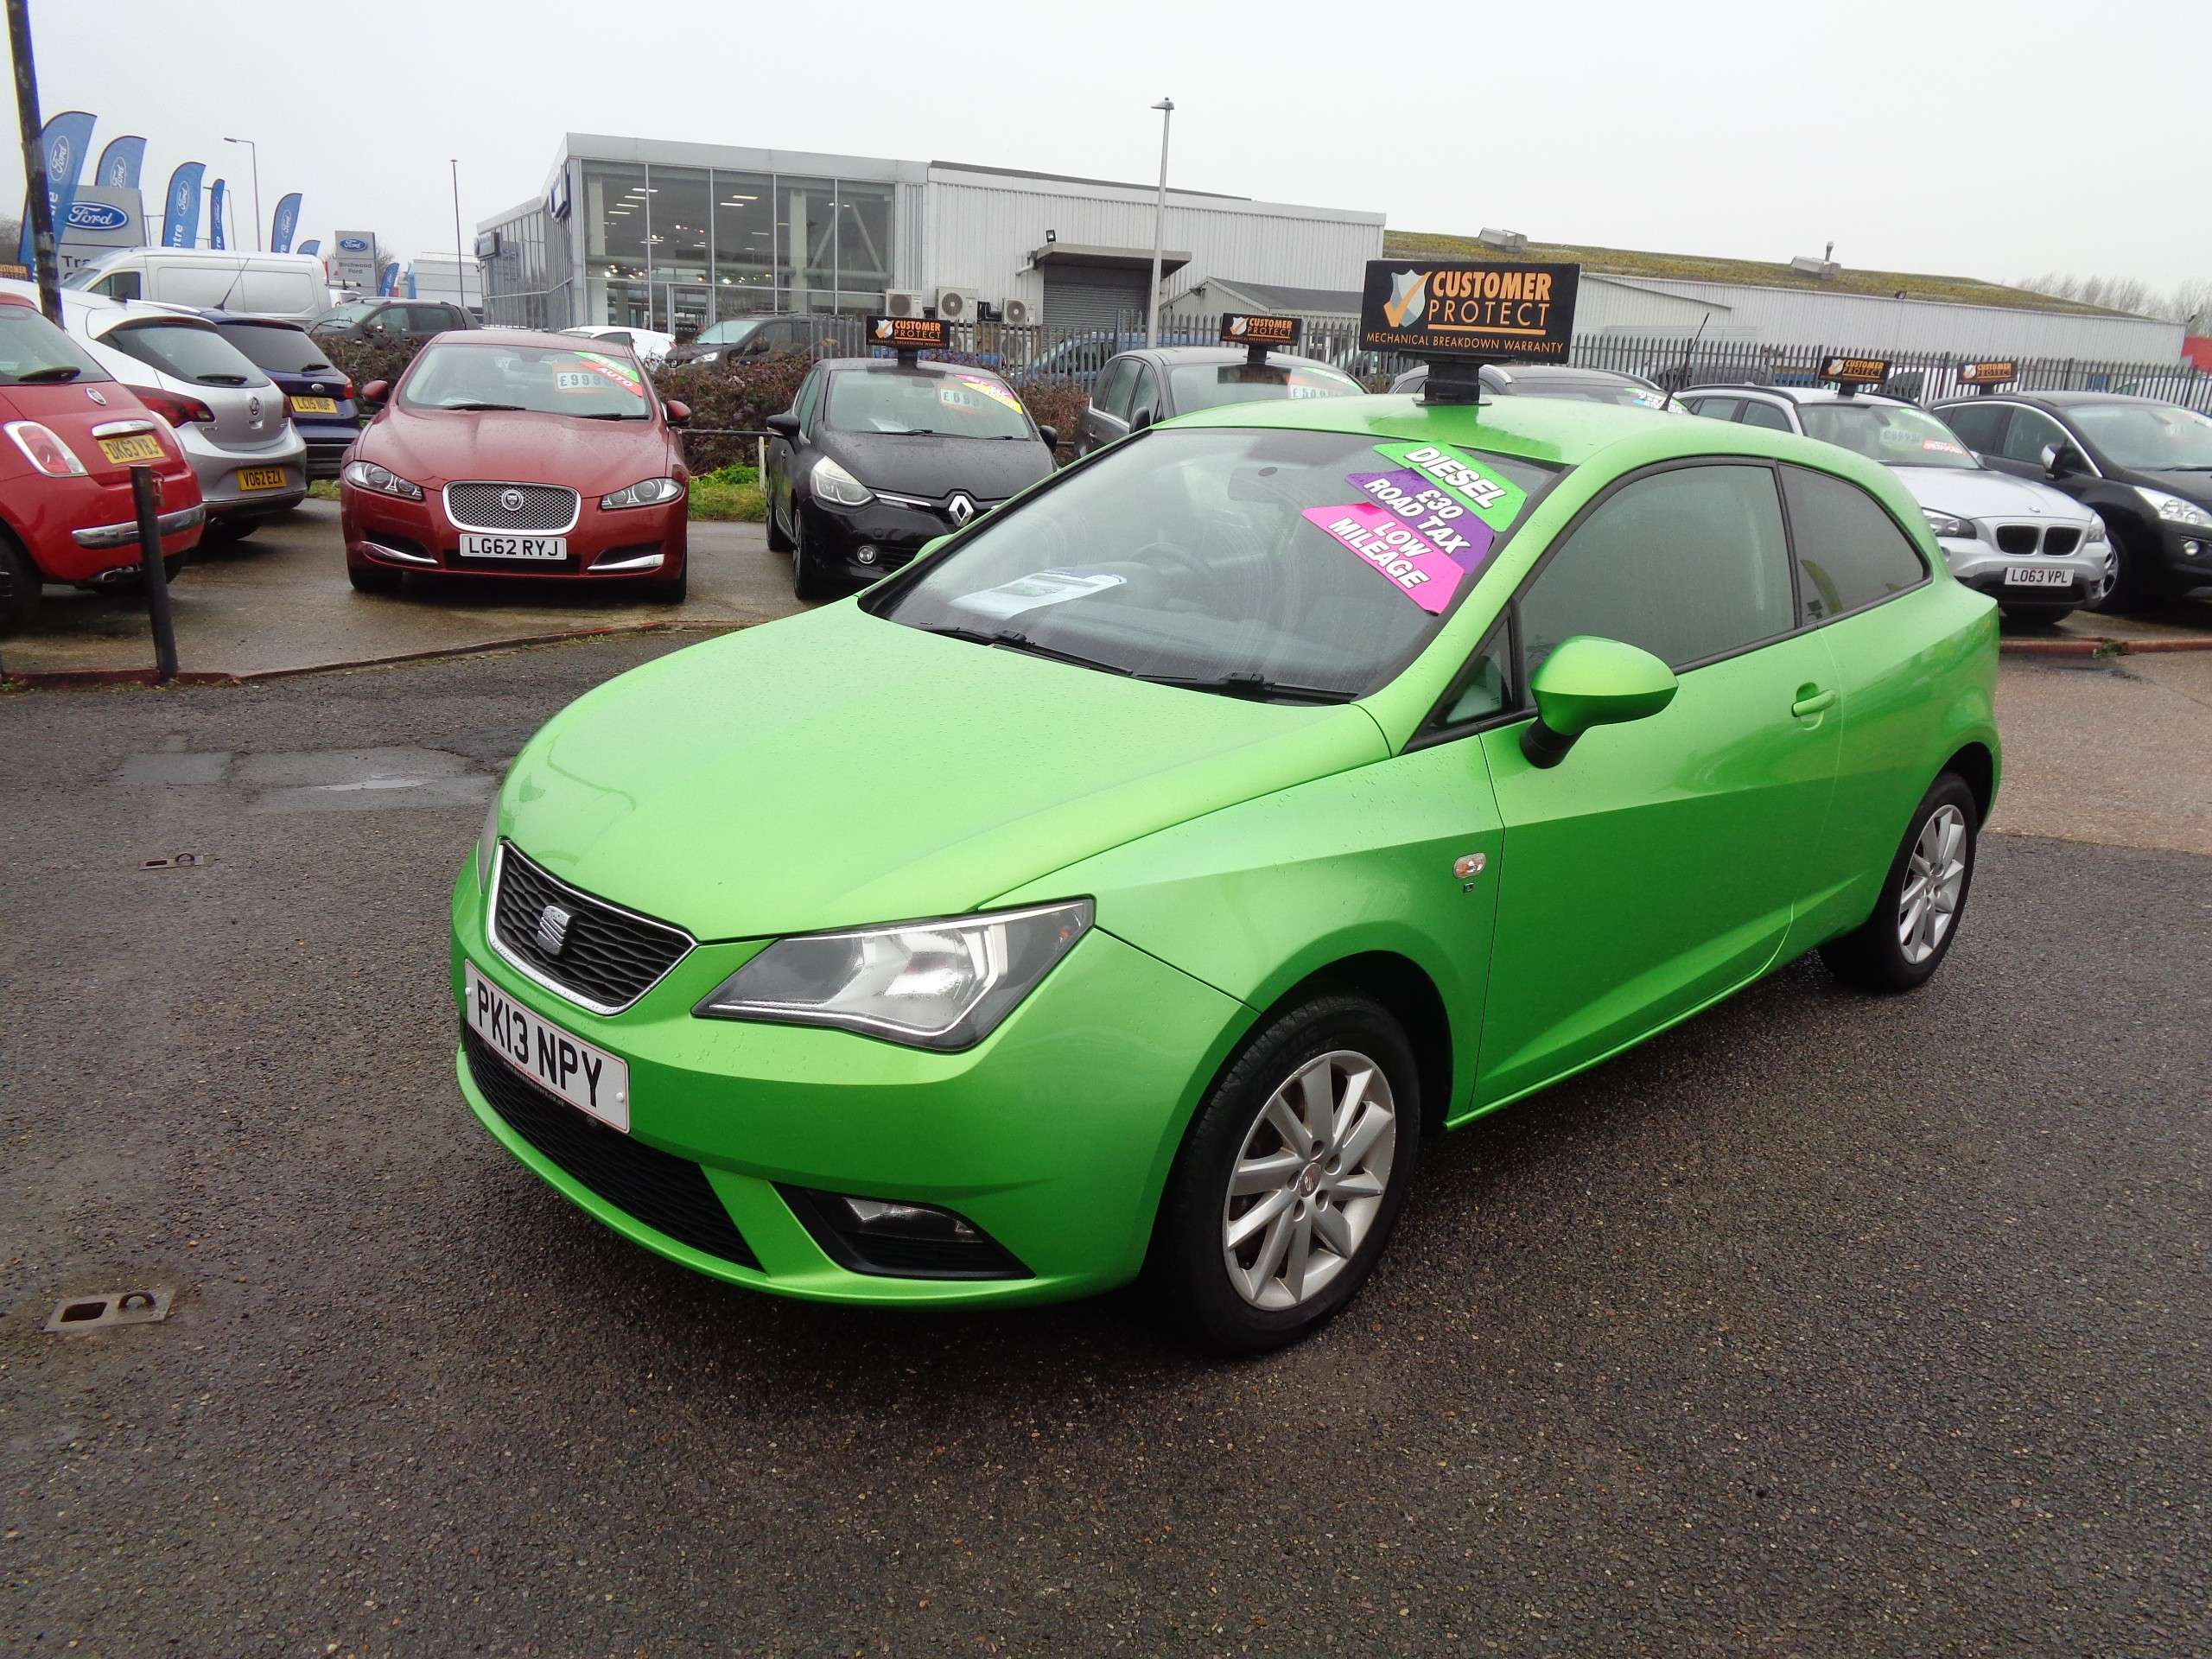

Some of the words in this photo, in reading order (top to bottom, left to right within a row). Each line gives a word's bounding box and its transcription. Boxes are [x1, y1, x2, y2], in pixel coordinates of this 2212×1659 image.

[68, 205, 113, 226] Ford
[1432, 270, 1553, 301] CUSTOMER
[1249, 317, 1294, 329] CUSTOMER
[1428, 300, 1551, 327] PROTECT
[893, 329, 942, 340] PROTECT
[894, 320, 942, 332] CUSTOMER
[1247, 326, 1293, 337] PROTECT
[1366, 332, 1430, 346] MECHANICAL
[1433, 337, 1500, 350] BREAKDOWN
[1504, 340, 1564, 353] WARRANTY
[1842, 366, 1883, 376] PROTECT
[1845, 359, 1885, 370] CUSTOMER
[1977, 362, 2012, 371] CUSTOMER
[267, 469, 283, 485] EZX
[1404, 446, 1508, 510] DIESEL
[1414, 488, 1465, 519] £30
[1363, 477, 1426, 518] ROAD
[1416, 514, 1471, 555] TAX
[468, 537, 517, 556] LG62
[522, 539, 558, 557] RYJ
[1372, 520, 1433, 558] LOW
[1327, 517, 1432, 590] MILEAGE
[2011, 569, 2044, 582] LO63
[2048, 569, 2068, 583] VPL
[477, 978, 530, 1065] PK13
[537, 1025, 603, 1109] NPY
